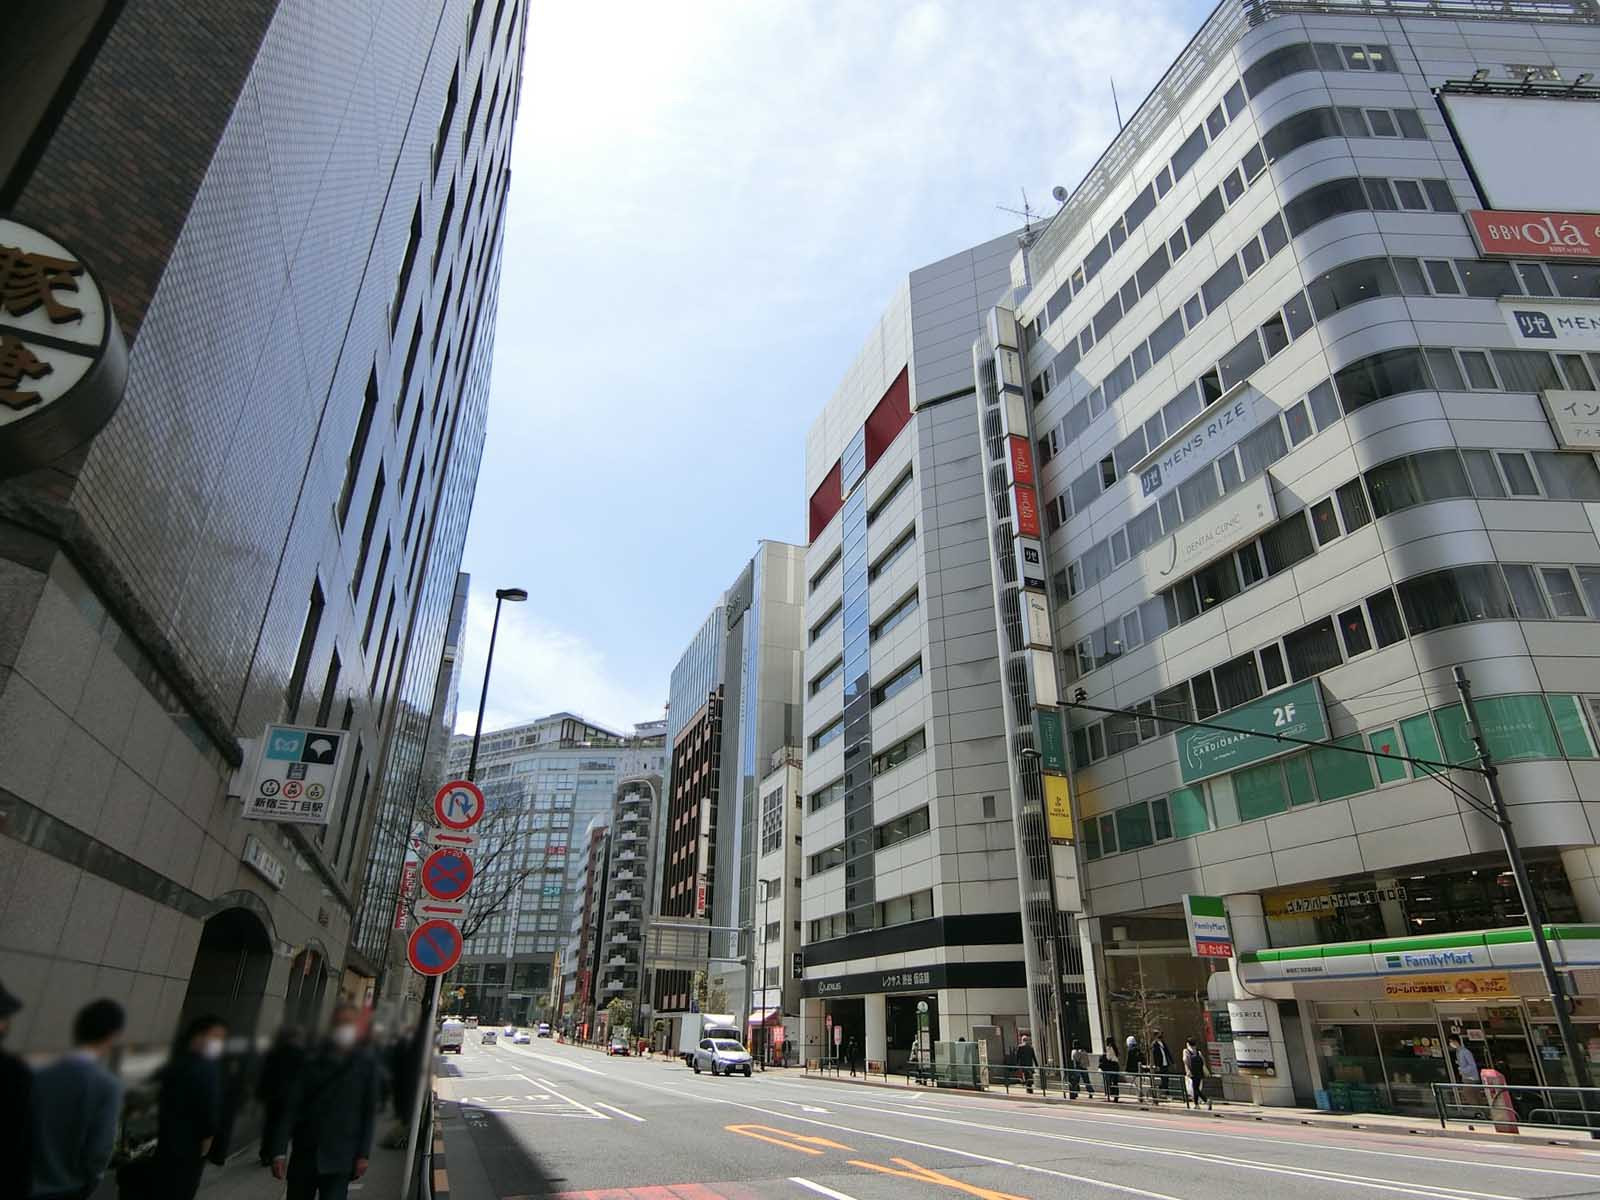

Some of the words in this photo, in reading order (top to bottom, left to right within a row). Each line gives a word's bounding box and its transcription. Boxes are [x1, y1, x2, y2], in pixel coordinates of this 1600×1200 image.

[1521, 216, 1590, 246] olá
[1164, 435, 1203, 472] MEN'S
[1207, 402, 1245, 438] RIZE
[1186, 533, 1213, 553] DENTAL
[1273, 703, 1296, 727] 2F
[255, 797, 324, 812] 新宿三丁目駅
[1194, 921, 1227, 932] FamilyMart
[1405, 952, 1474, 967] FamilyMart
